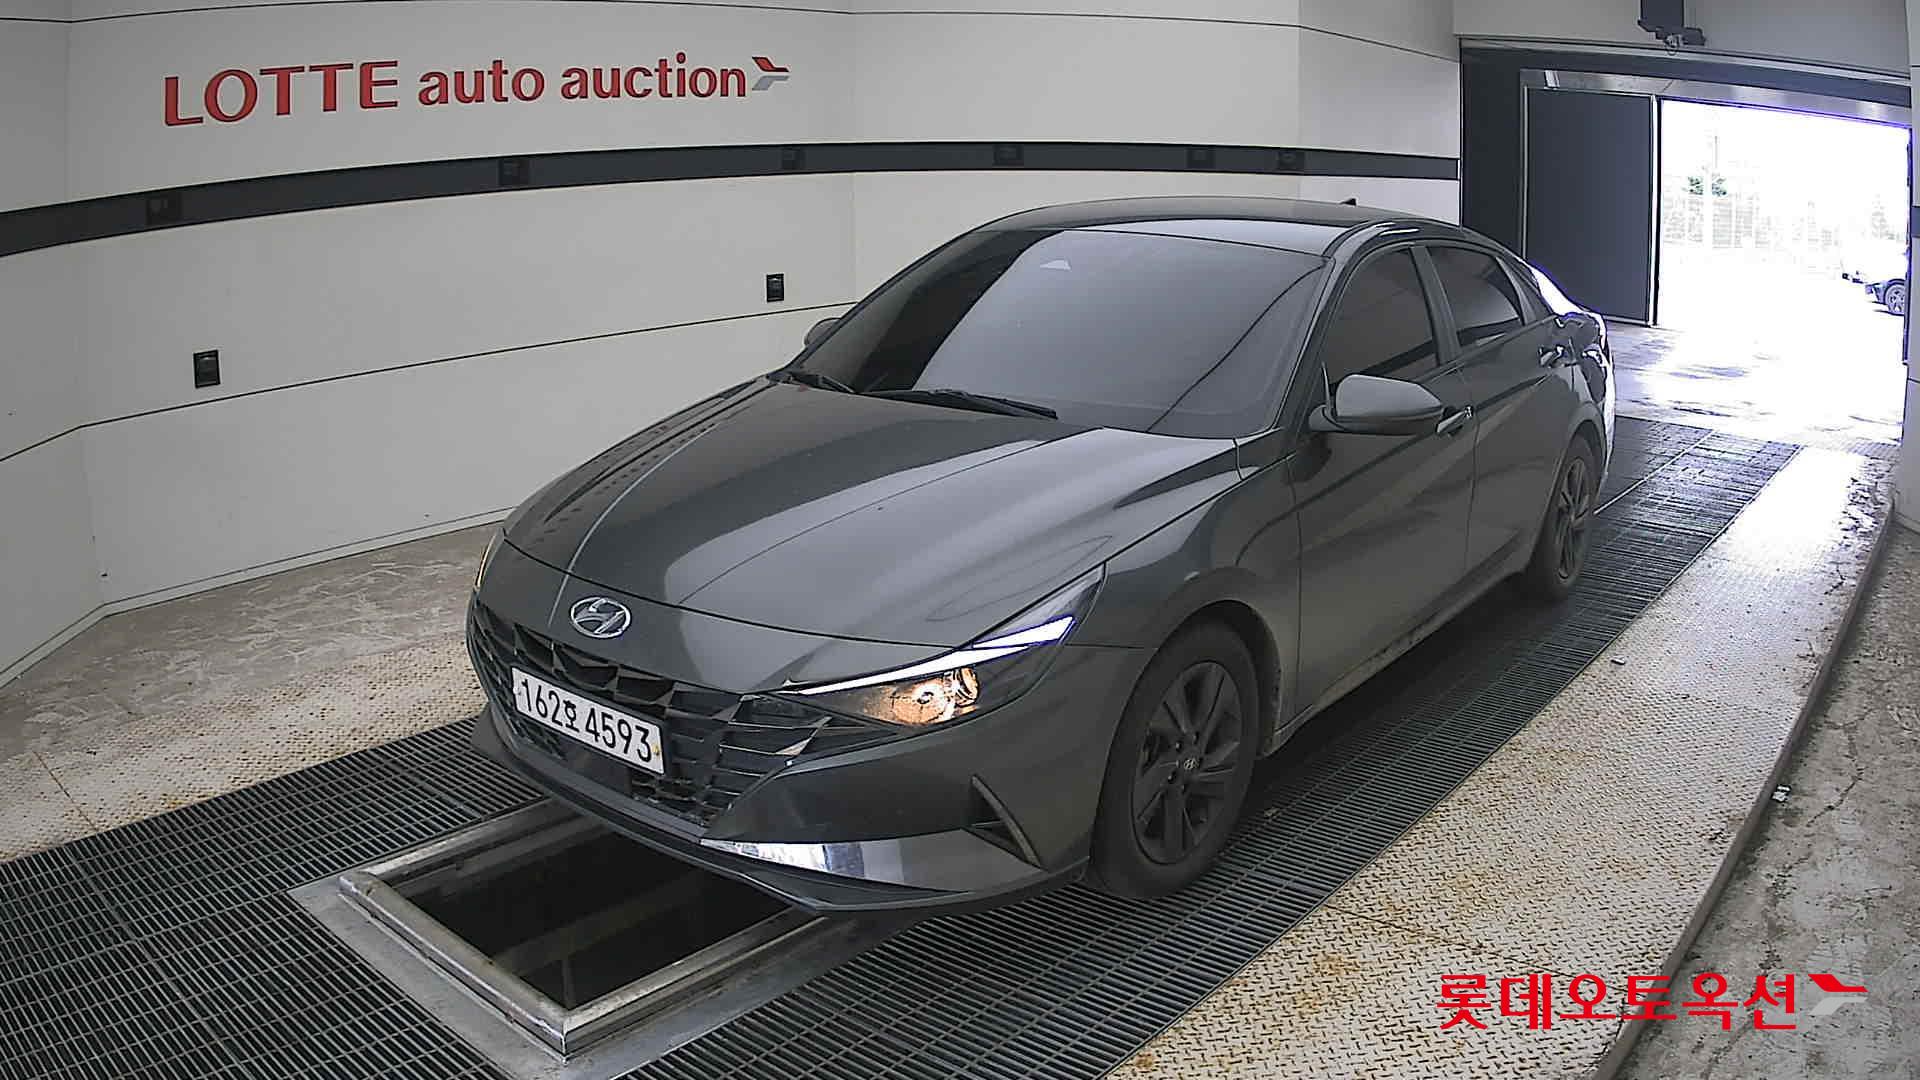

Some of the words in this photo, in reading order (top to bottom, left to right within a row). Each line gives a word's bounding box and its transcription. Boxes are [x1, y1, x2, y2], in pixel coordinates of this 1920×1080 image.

[164, 61, 399, 126] LOTTE
[418, 59, 547, 106] auto
[560, 51, 748, 100] auction
